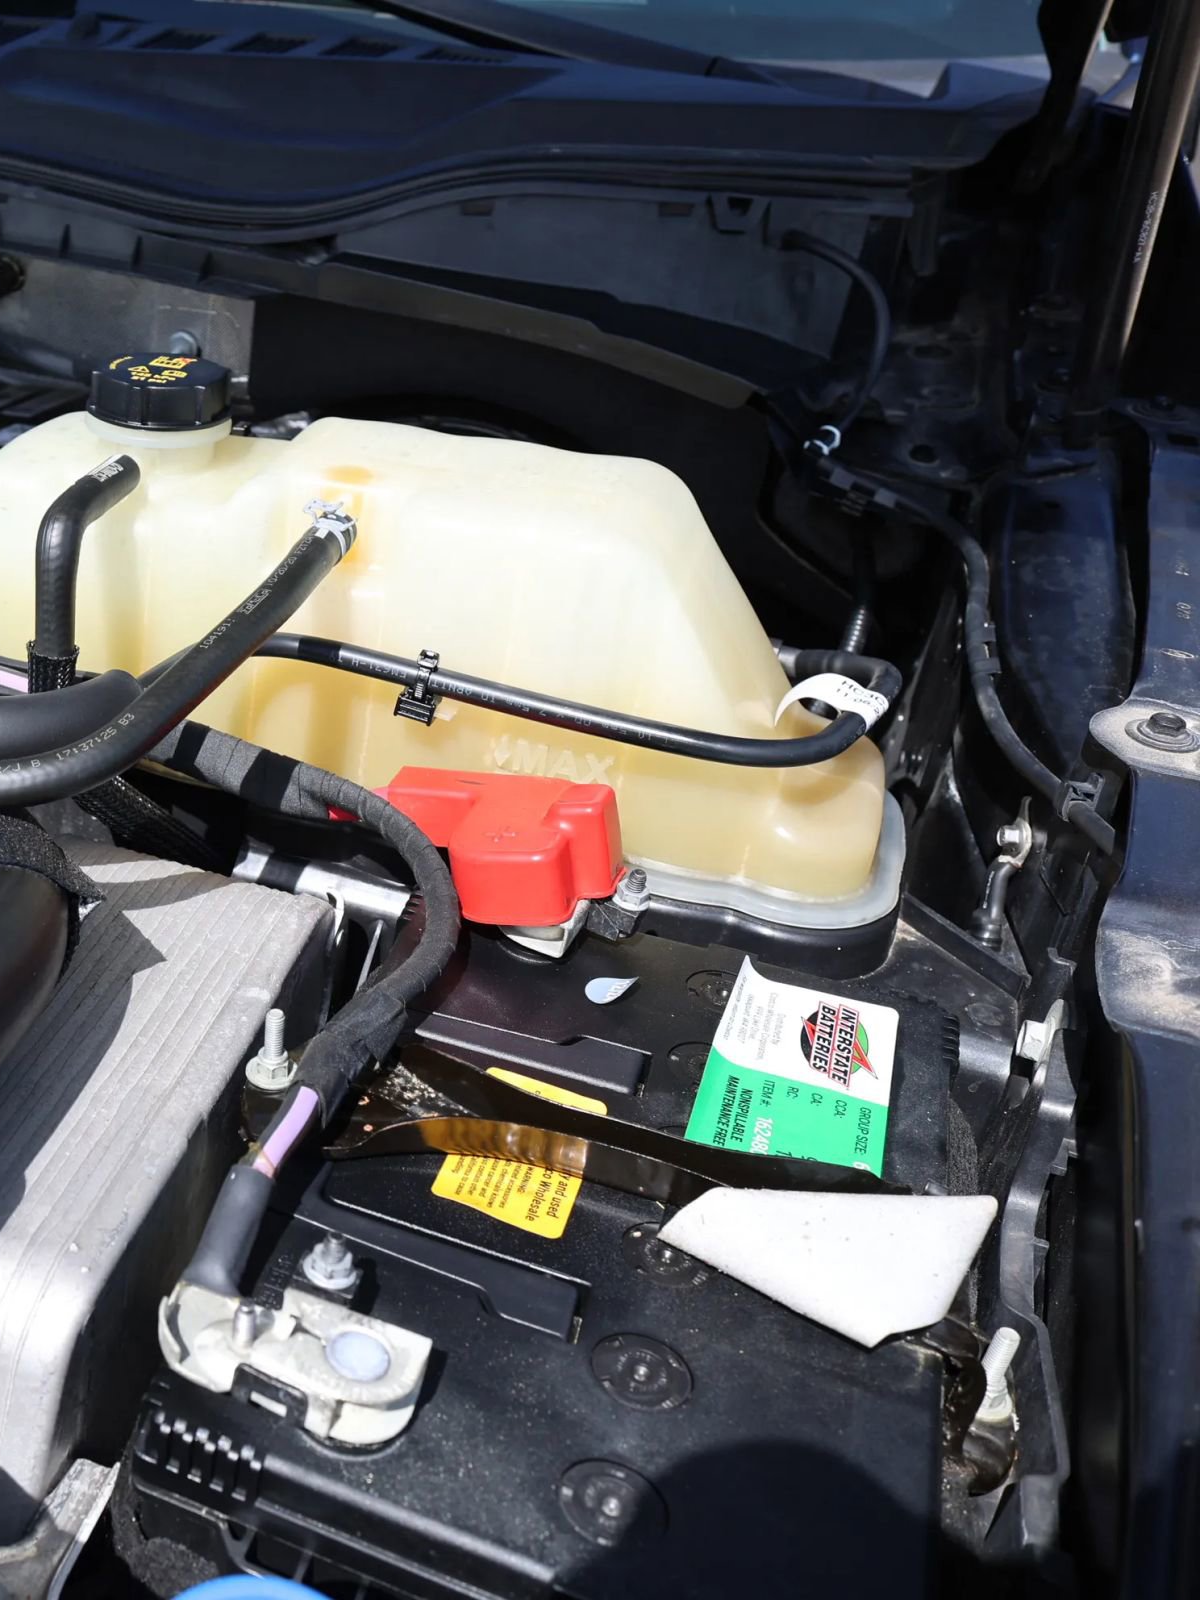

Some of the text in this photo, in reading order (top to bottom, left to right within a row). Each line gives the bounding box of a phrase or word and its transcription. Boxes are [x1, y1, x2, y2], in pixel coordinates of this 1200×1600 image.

[31, 759, 41, 769] B
[55, 726, 118, 761] 17:37:25
[117, 712, 135, 727] B3
[512, 737, 616, 784] MAX
[812, 1005, 837, 1074] BATTERIES
[832, 1007, 857, 1086] INTERSTATE
[762, 1079, 776, 1101] ITEM
[786, 1085, 799, 1100] RC:
[810, 1092, 824, 1107] CA:
[712, 1074, 740, 1147] MAINTENANCE FREE
[730, 1088, 753, 1143] NONSPILLABLE
[834, 1099, 848, 1119] CCA:
[857, 1107, 872, 1135] GROUP
[524, 1178, 551, 1224] Wholesale
[545, 1196, 562, 1218] used
[553, 1180, 568, 1197] and
